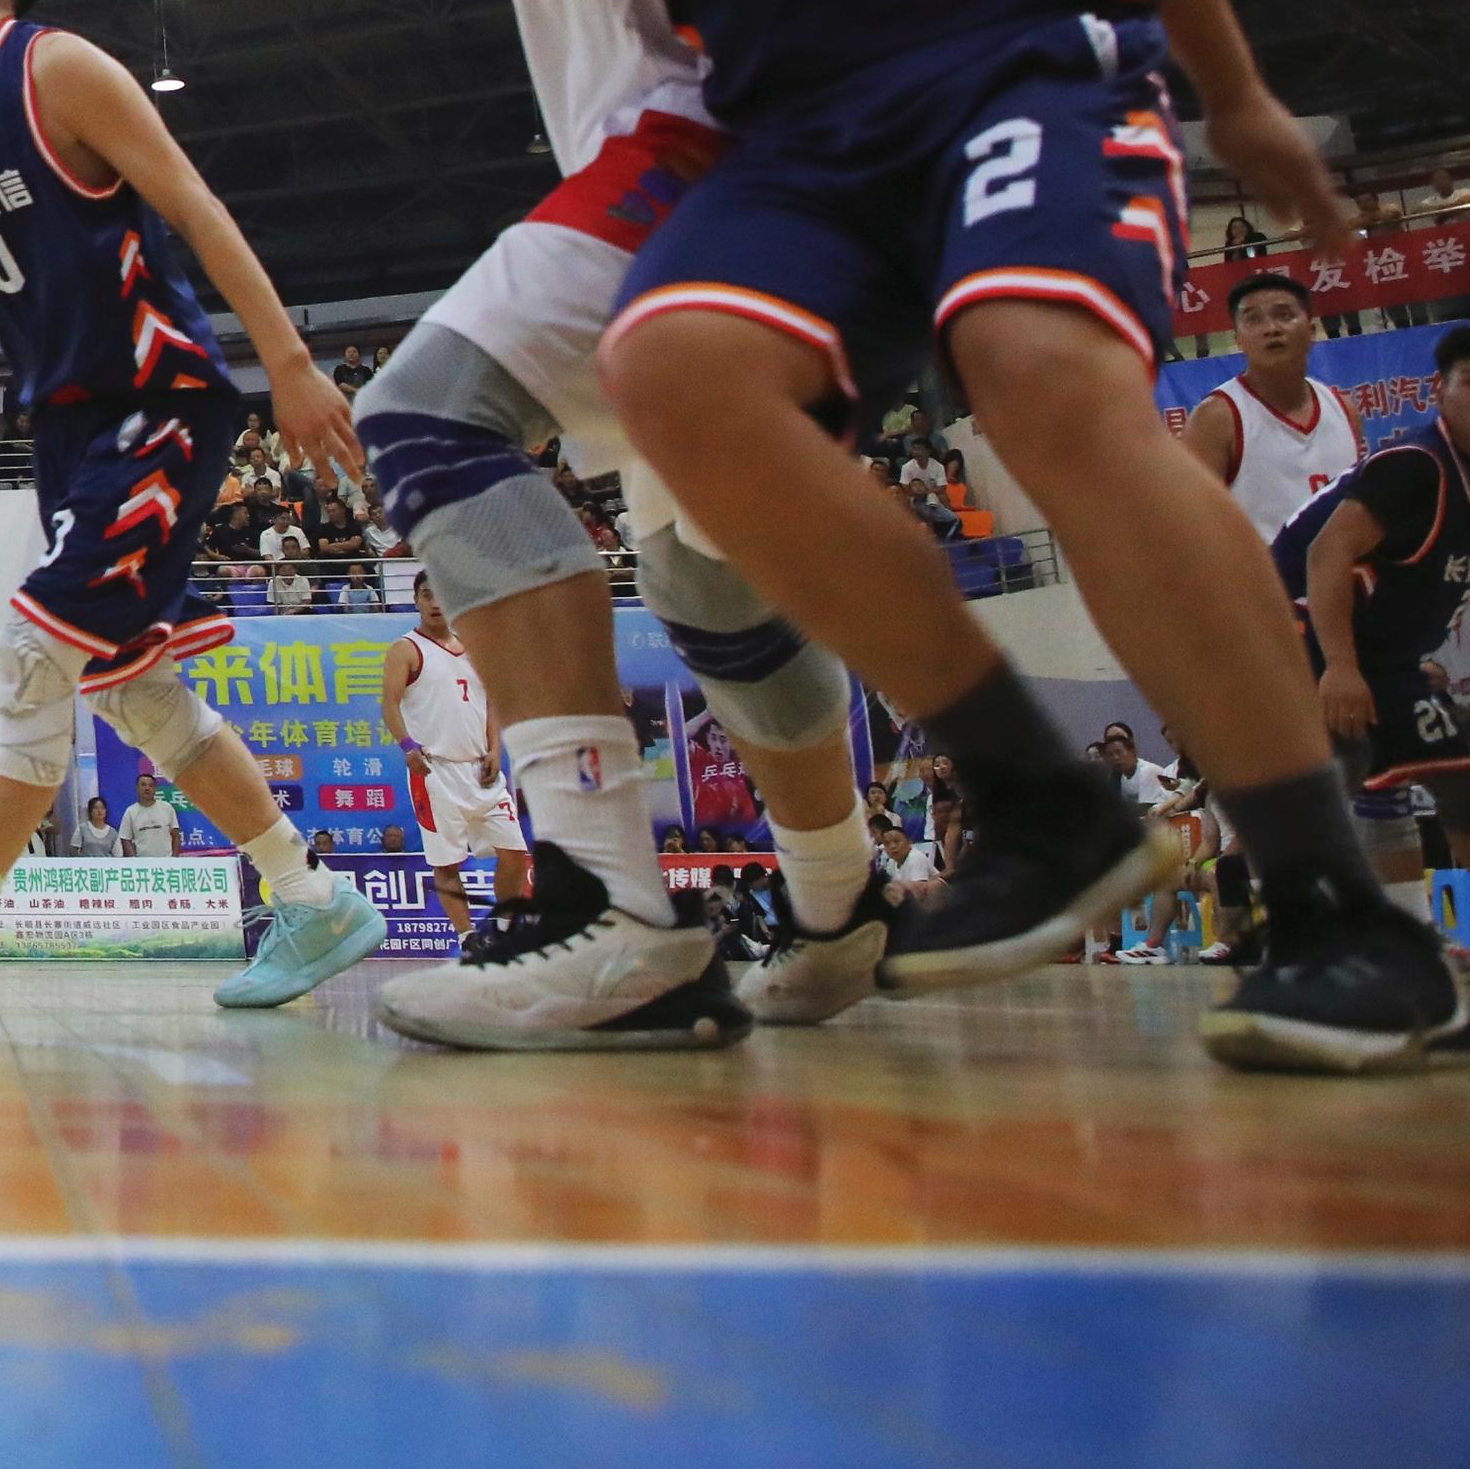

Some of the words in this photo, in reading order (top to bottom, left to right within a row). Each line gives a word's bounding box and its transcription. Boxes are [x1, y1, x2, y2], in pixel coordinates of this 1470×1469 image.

[964, 118, 1043, 228] 2
[173, 640, 393, 706] 来体育
[457, 679, 469, 703] 7
[332, 757, 383, 777] 轮滑
[335, 789, 386, 809] 舞蹈
[498, 802, 516, 821] 7
[12, 867, 229, 894] 贵州鸿稻农副产品开发有限公司
[662, 867, 712, 889] 传媒
[397, 922, 477, 934] 187982743
